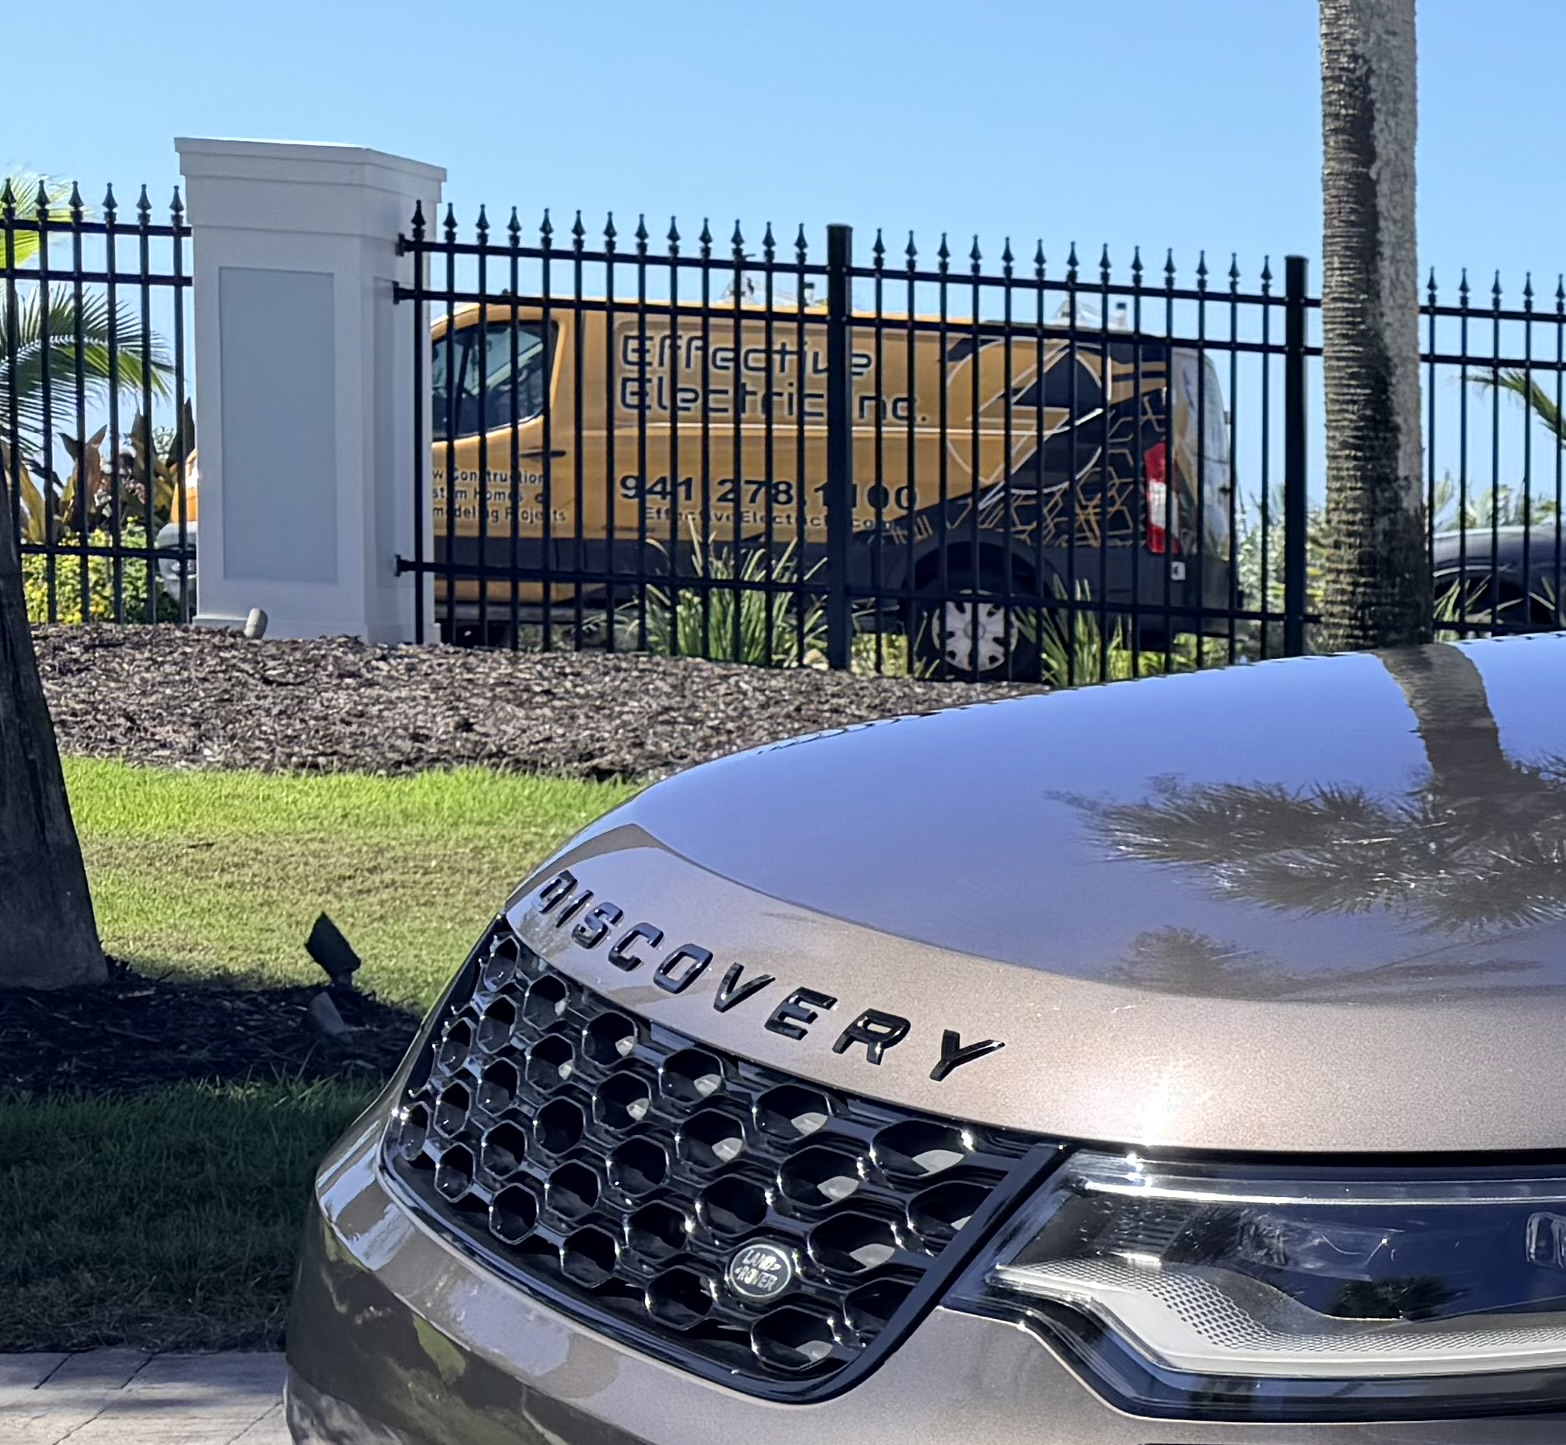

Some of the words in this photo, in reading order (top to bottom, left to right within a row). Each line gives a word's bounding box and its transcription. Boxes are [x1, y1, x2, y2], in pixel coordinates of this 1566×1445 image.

[622, 335, 873, 376] Effectve
[621, 376, 823, 417] Electric
[538, 869, 1006, 1082] DISCOVERY
[735, 1265, 778, 1292] ROVER
[742, 1249, 779, 1271] LAND
